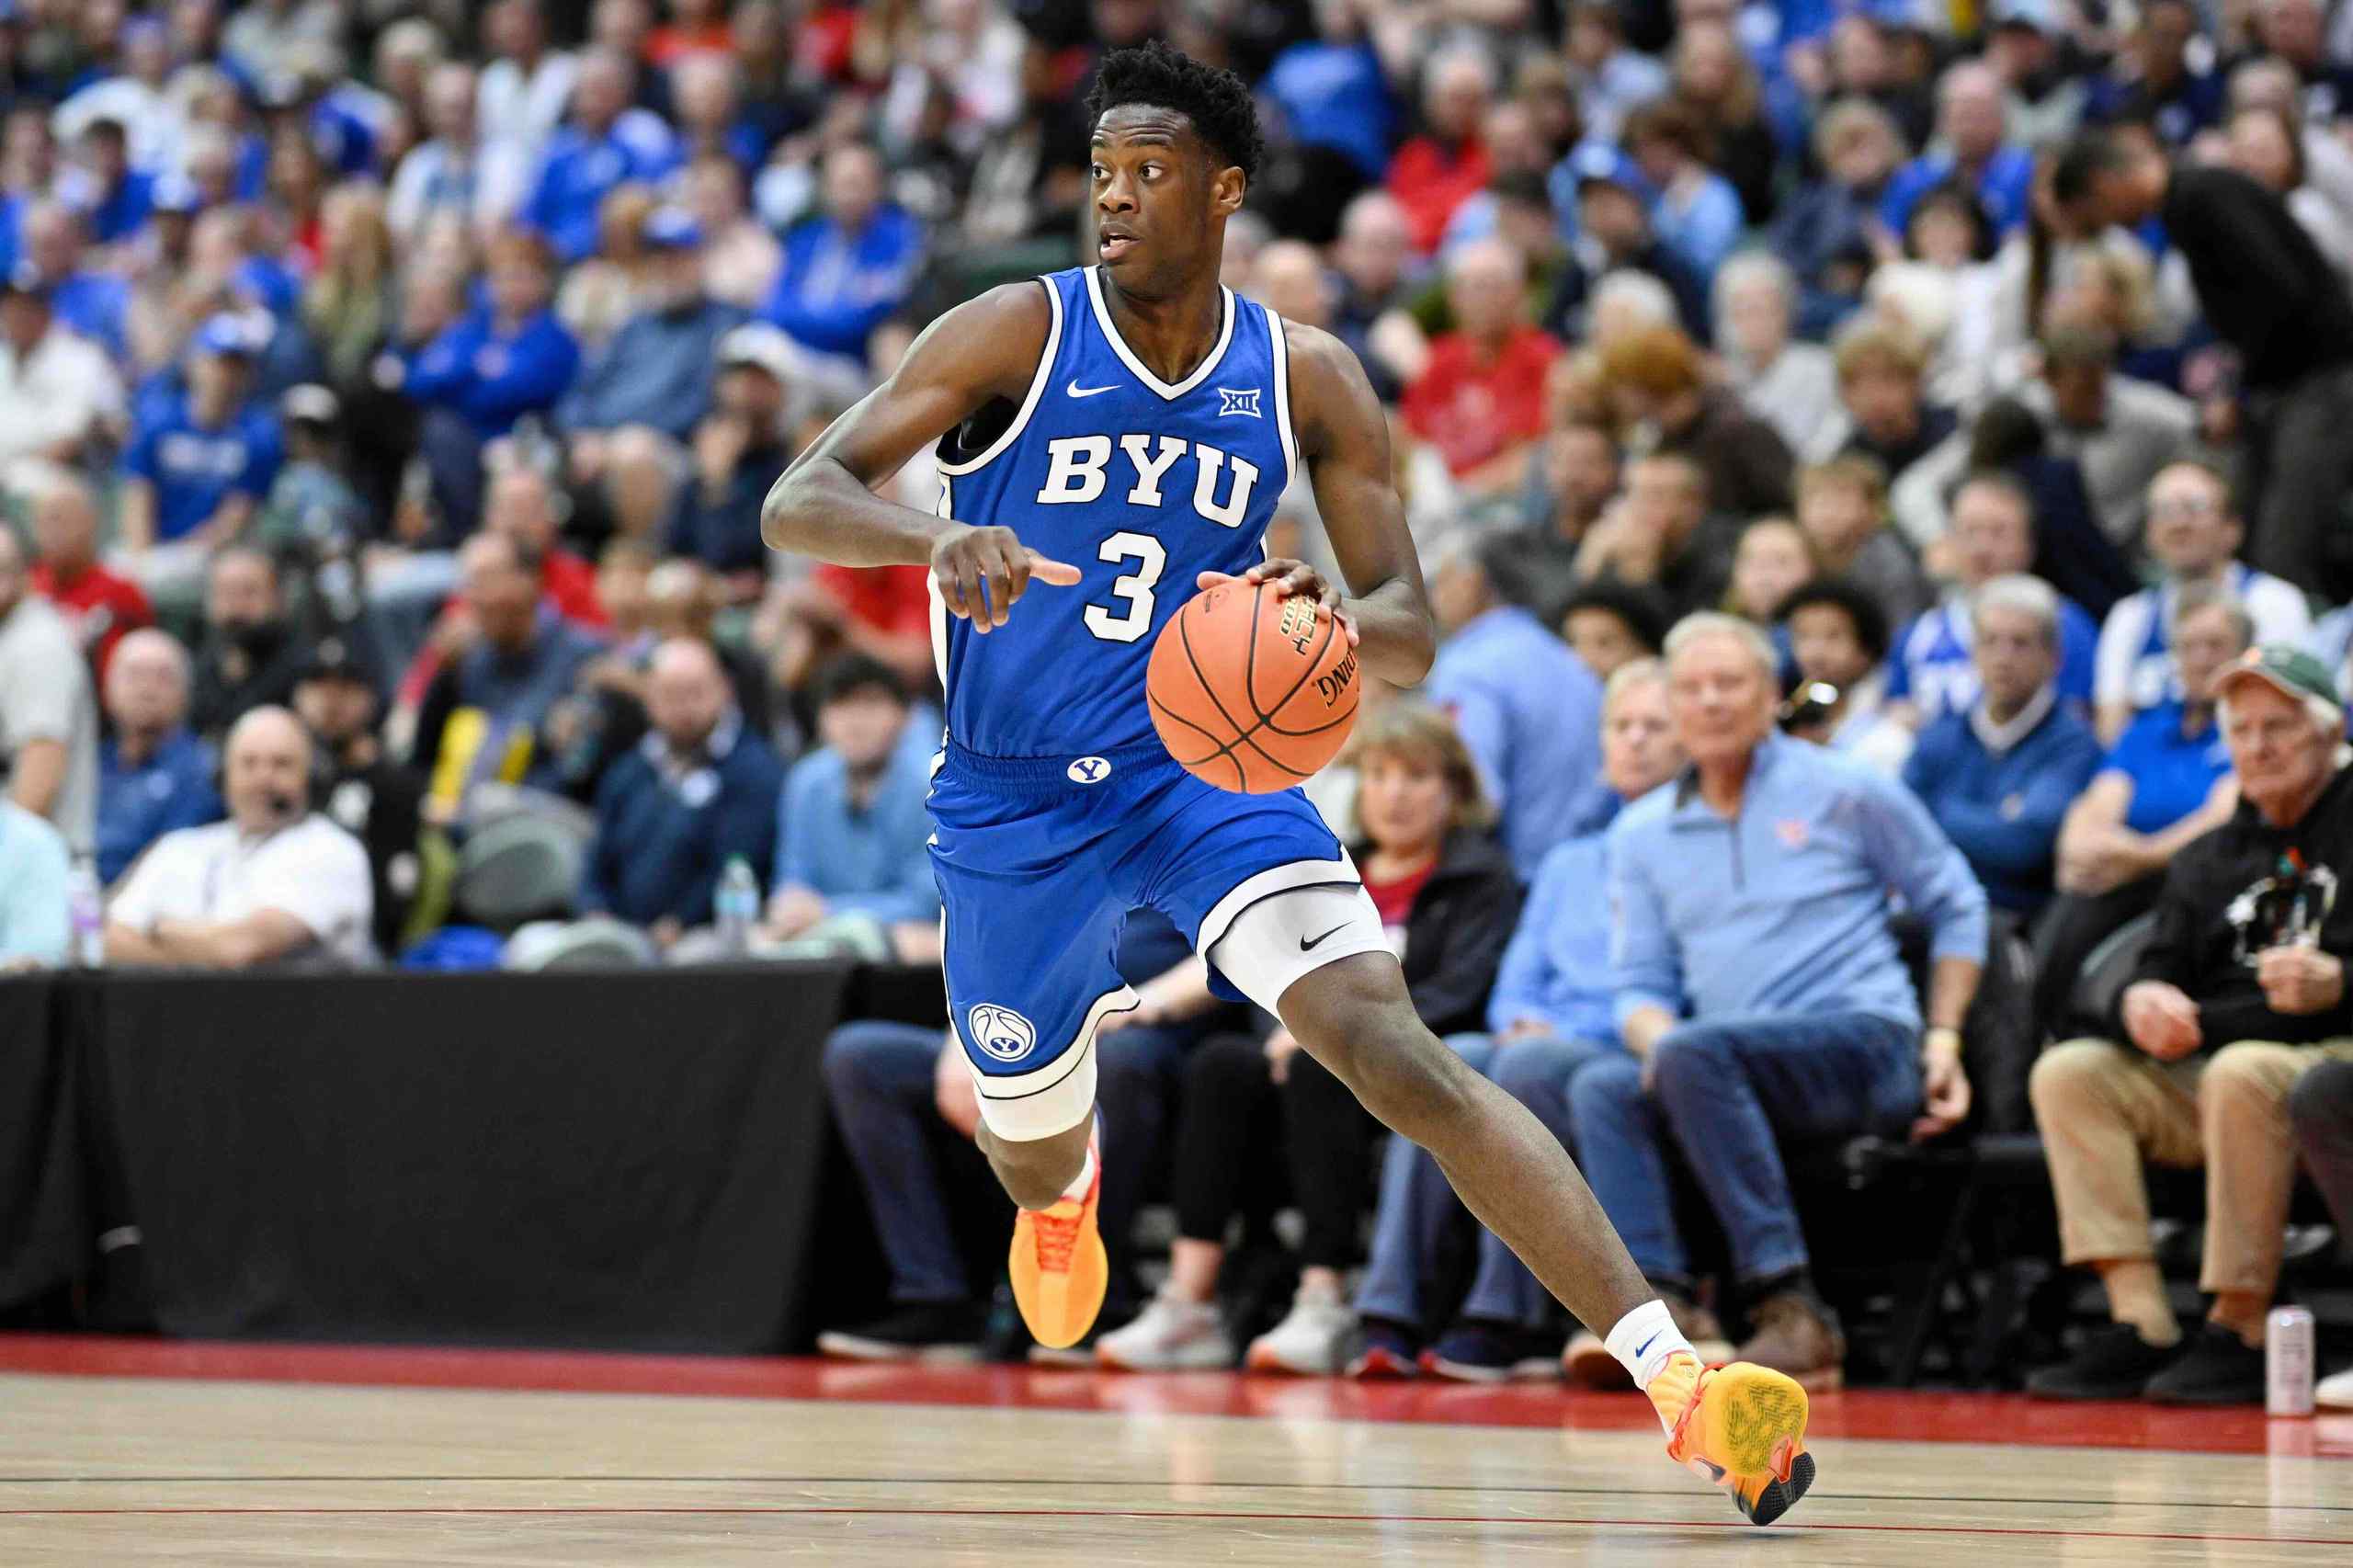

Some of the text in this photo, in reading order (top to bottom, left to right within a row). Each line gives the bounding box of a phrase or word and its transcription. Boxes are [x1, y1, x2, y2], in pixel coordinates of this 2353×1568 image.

[1036, 434, 1259, 528] BYU
[1083, 531, 1166, 643] 3
[1316, 647, 1358, 707] DING
[1074, 759, 1102, 780] Y
[993, 1038, 1014, 1051] Y
